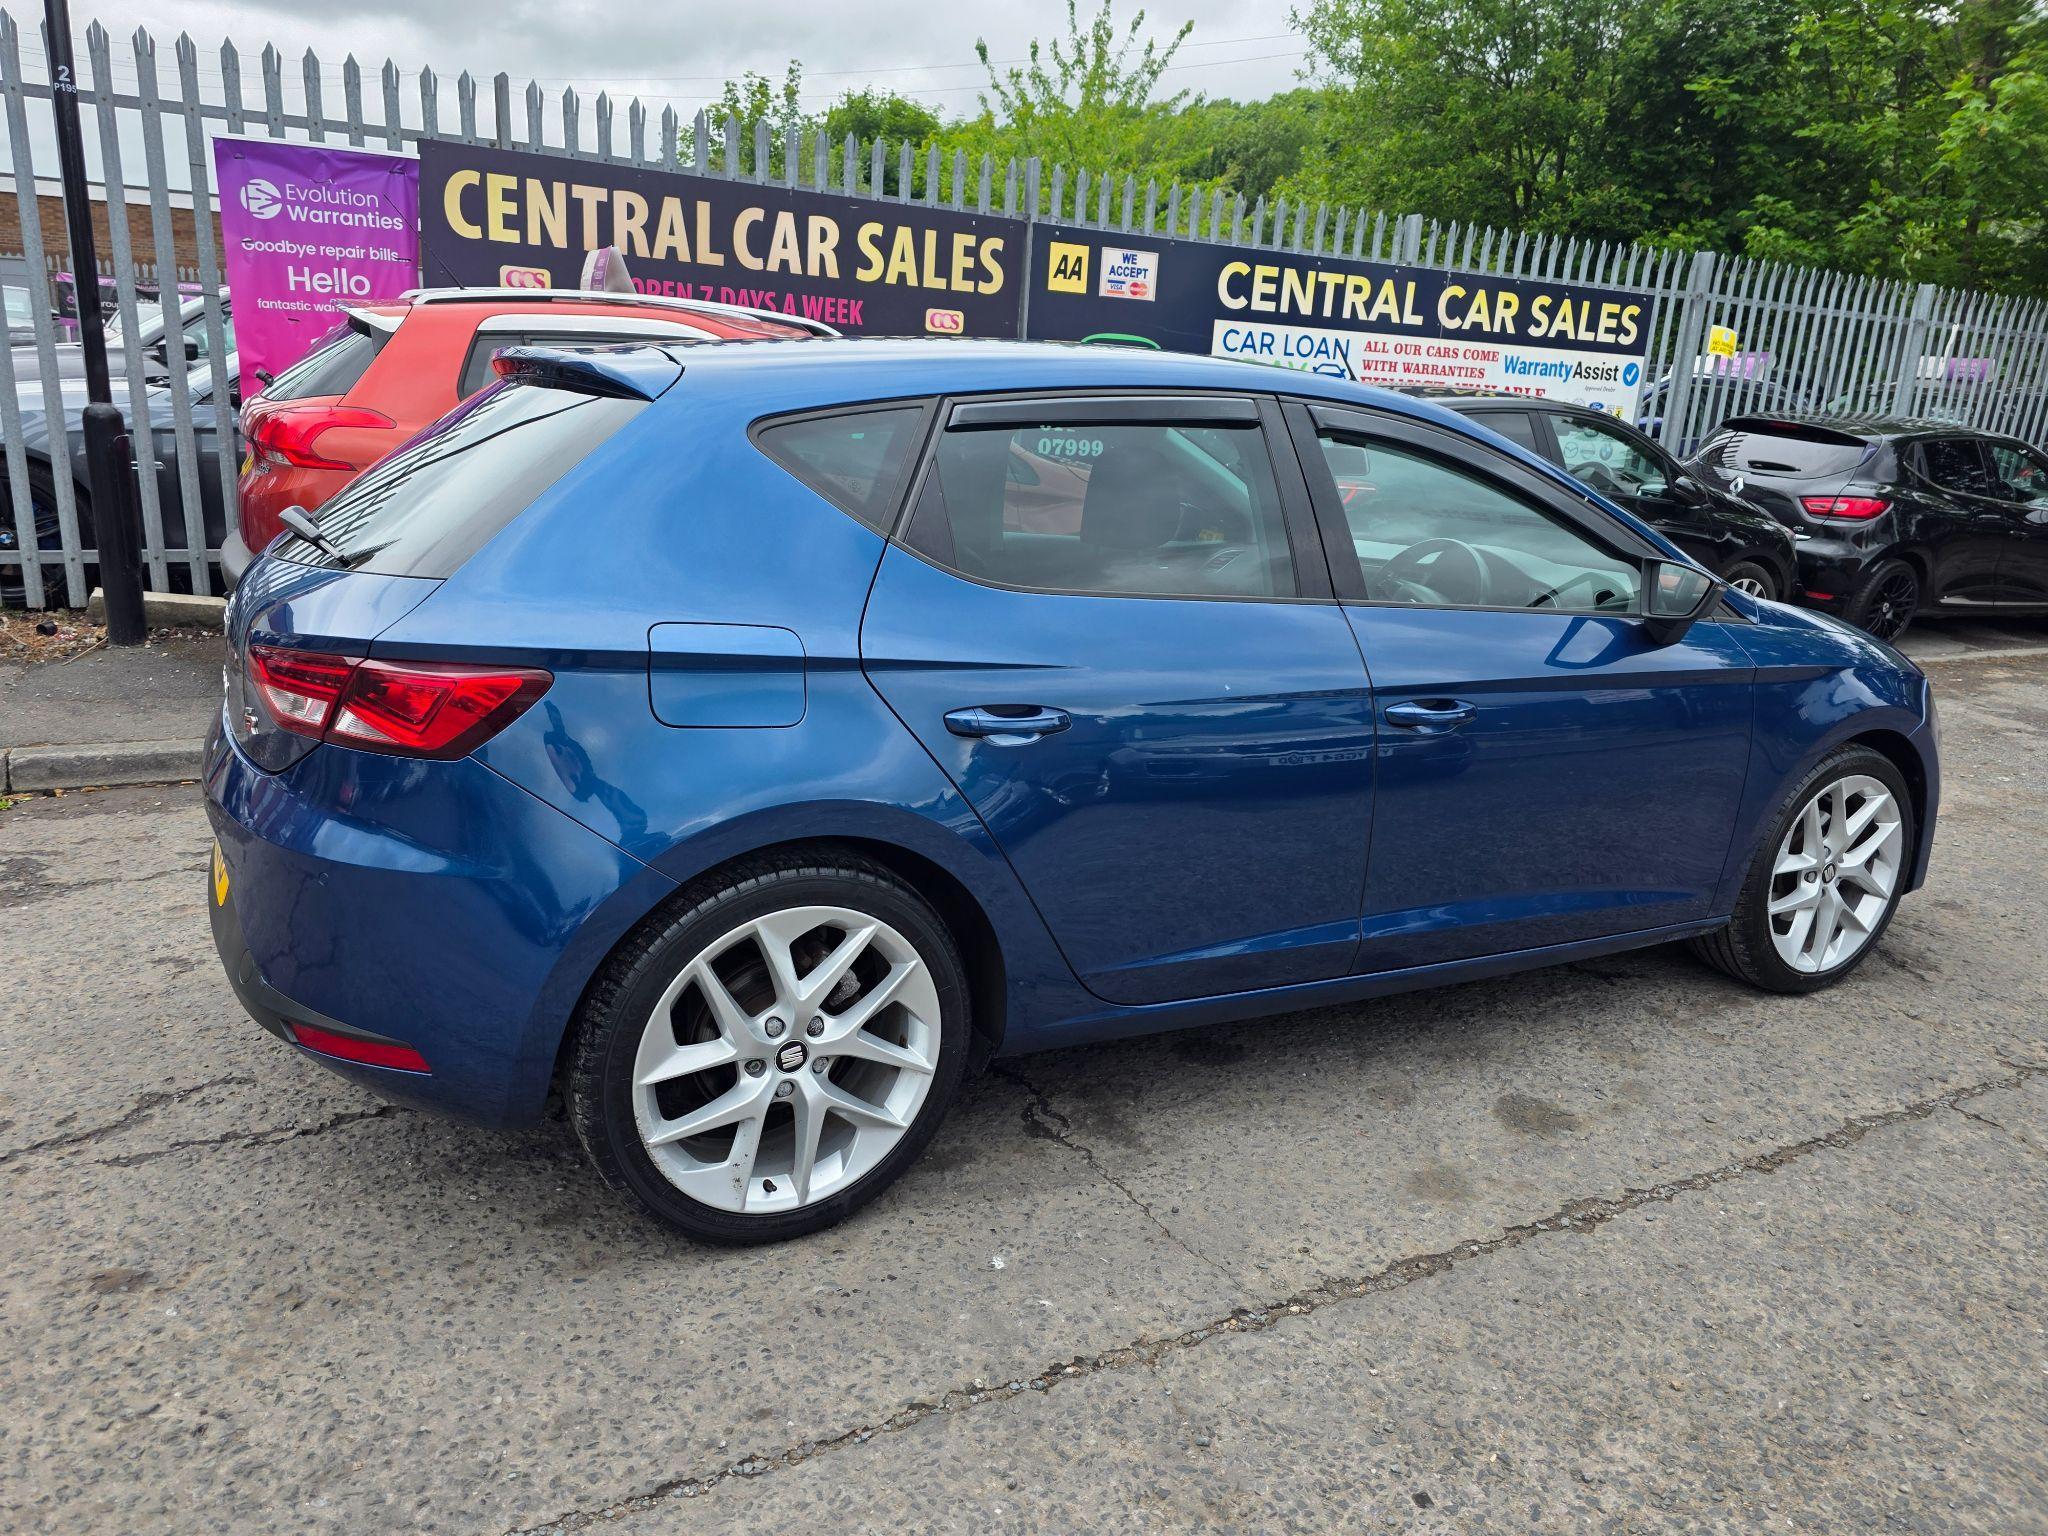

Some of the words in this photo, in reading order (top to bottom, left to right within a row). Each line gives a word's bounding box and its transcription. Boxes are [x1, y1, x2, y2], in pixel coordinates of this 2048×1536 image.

[57, 65, 71, 82] 2
[54, 82, 77, 94] P195
[285, 184, 380, 208] Evolution
[287, 204, 404, 231] Warranties
[443, 169, 725, 267] CENTRAL
[733, 207, 840, 279] CAR
[856, 222, 1005, 295] SALES
[241, 238, 317, 258] Goodbye
[319, 244, 366, 261] repair
[1122, 252, 1138, 265] WE
[1053, 254, 1083, 281] AA
[1108, 265, 1149, 280] ACCEPT
[287, 265, 371, 296] Hello
[257, 297, 312, 312] fantastic
[631, 277, 693, 300] OPEN
[700, 285, 714, 301] 7
[720, 287, 777, 312] DAYS
[783, 293, 797, 316] A
[802, 295, 864, 326] WEEK
[1217, 261, 1424, 326] CENTRAL
[1437, 285, 1520, 334] CAR
[1527, 294, 1642, 346] SALES
[1223, 329, 1275, 356] CAR
[1283, 333, 1351, 361] LOAN
[1364, 340, 1389, 354] ALL
[1394, 342, 1422, 356] OUR
[1427, 345, 1459, 359] CARS
[1463, 347, 1500, 362] COME
[1362, 359, 1400, 374] WITH
[1403, 362, 1486, 379] WARRANTIES
[1038, 438, 1104, 457] 07999
